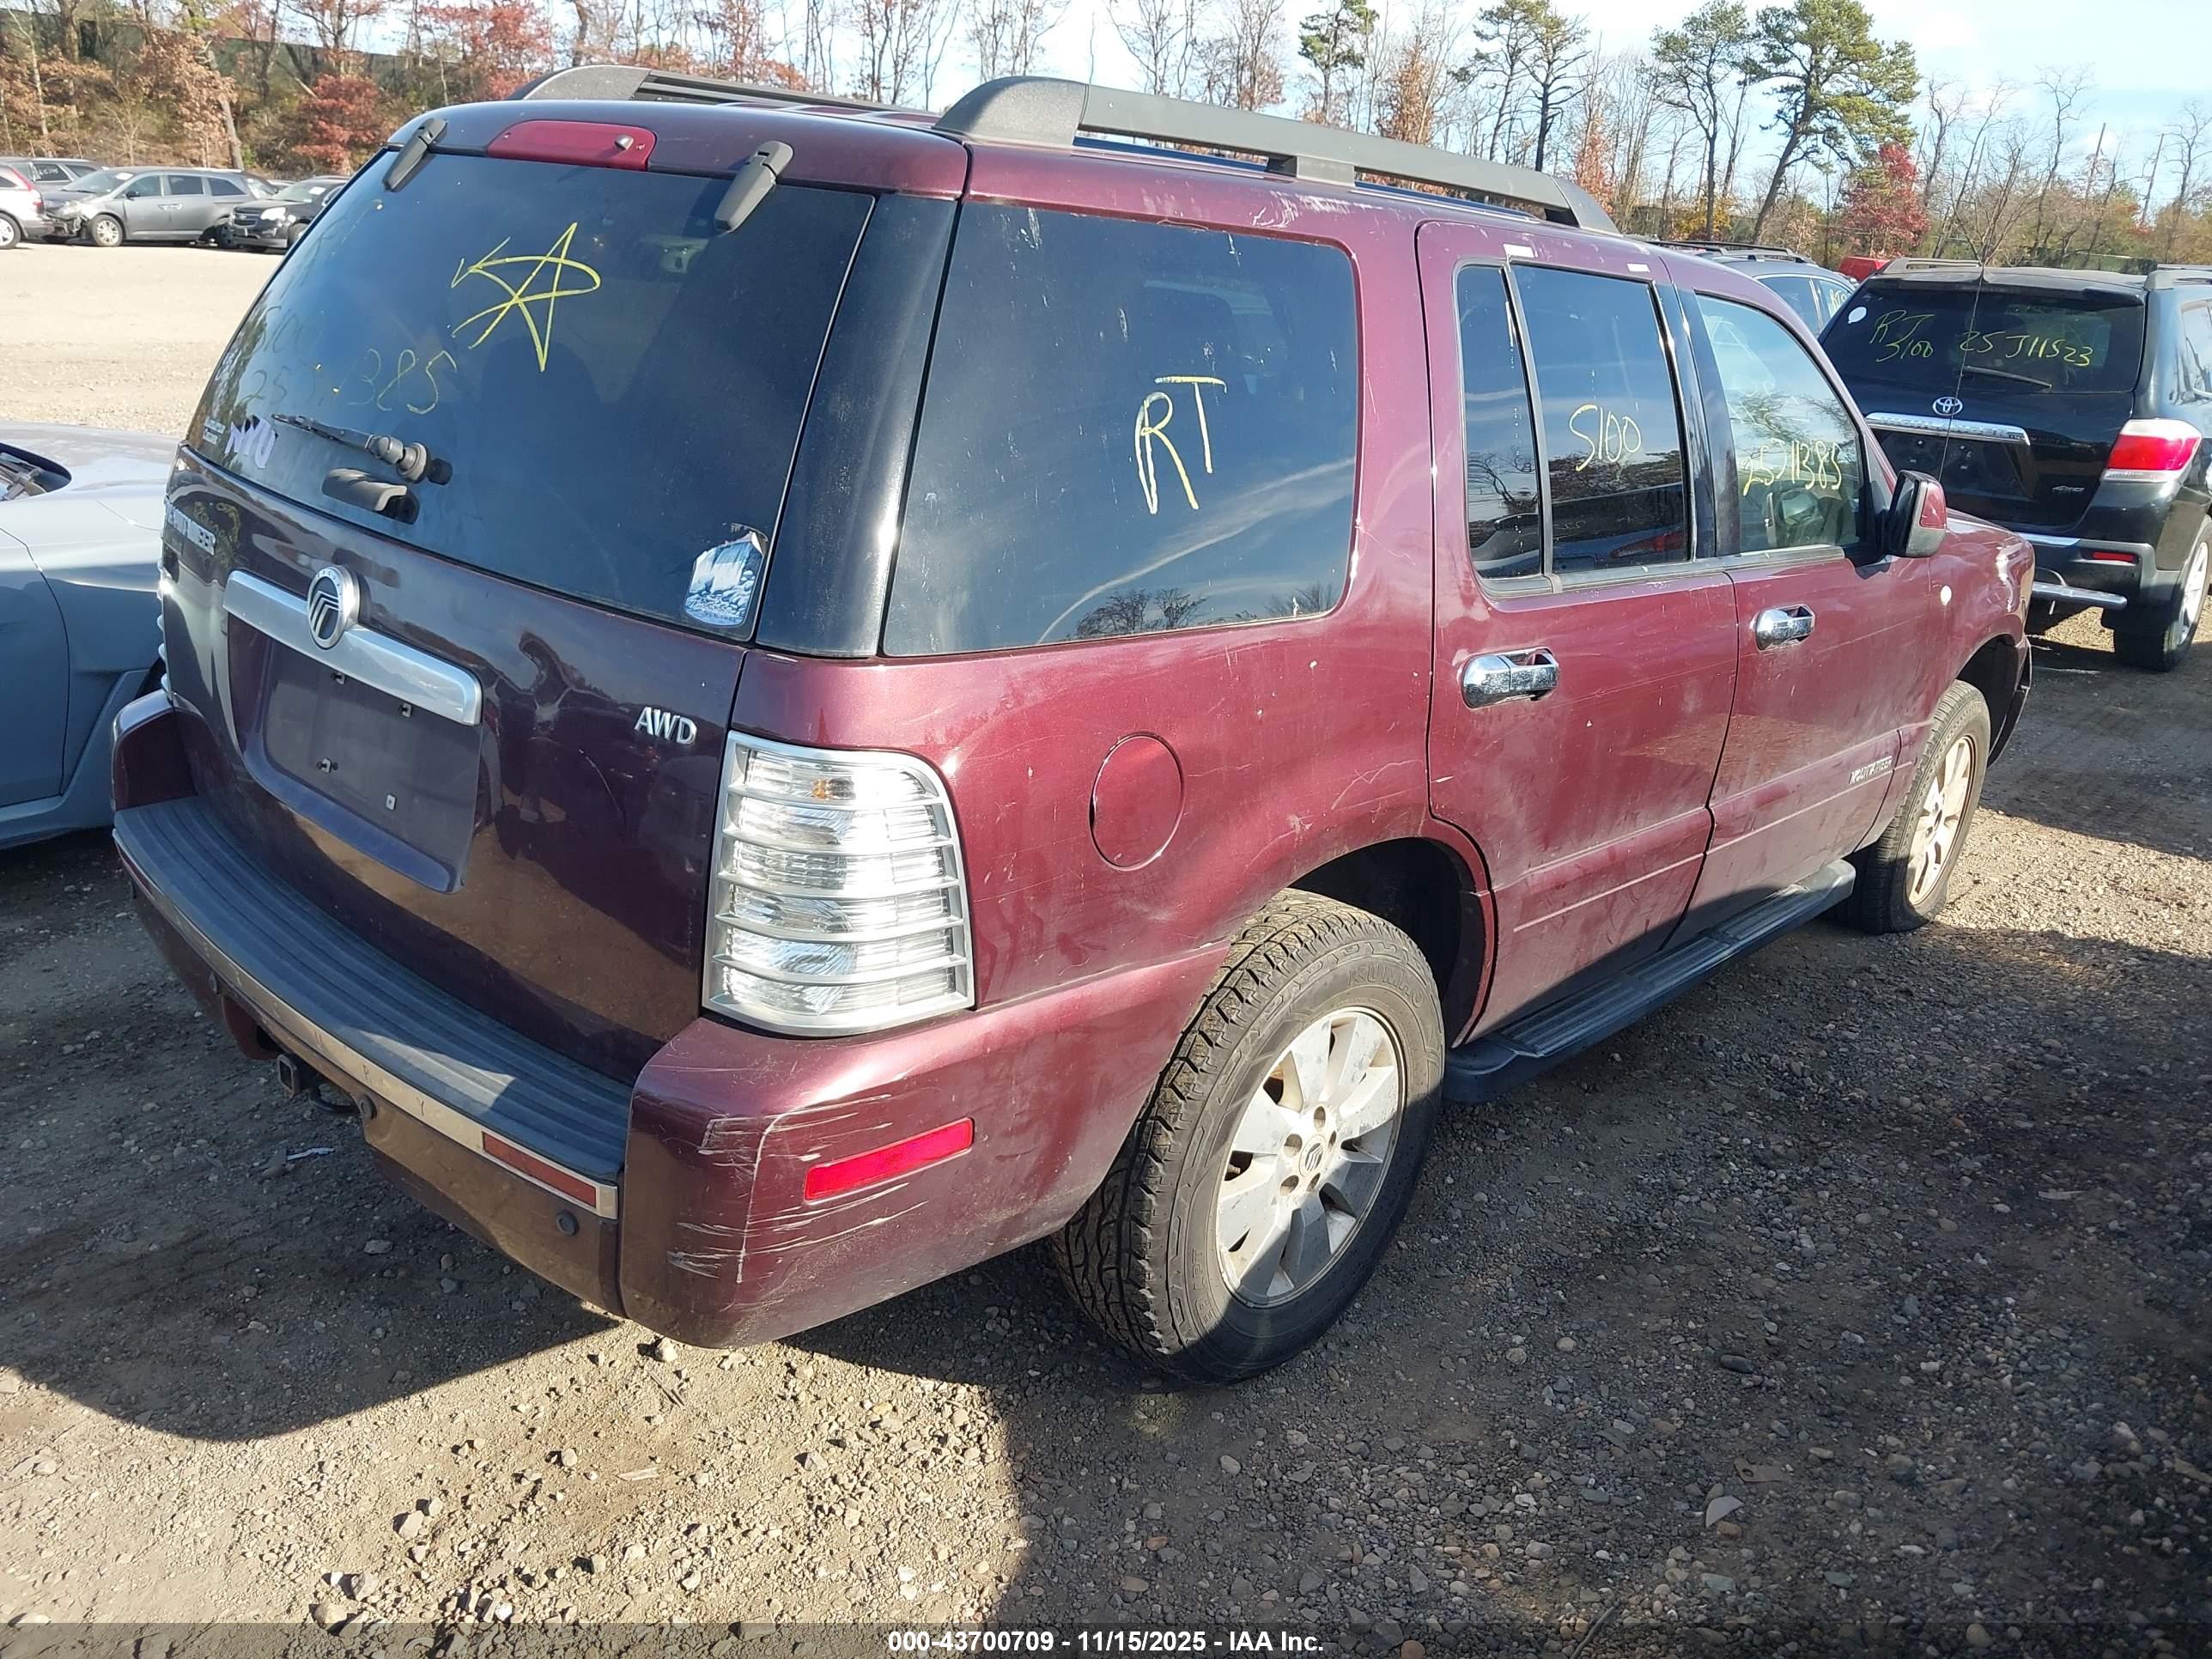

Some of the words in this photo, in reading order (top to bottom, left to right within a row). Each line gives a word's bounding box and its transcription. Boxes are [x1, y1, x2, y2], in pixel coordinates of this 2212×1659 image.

[1135, 375, 1227, 514] RT
[1570, 404, 1642, 471] S100
[634, 706, 697, 744] AWD
